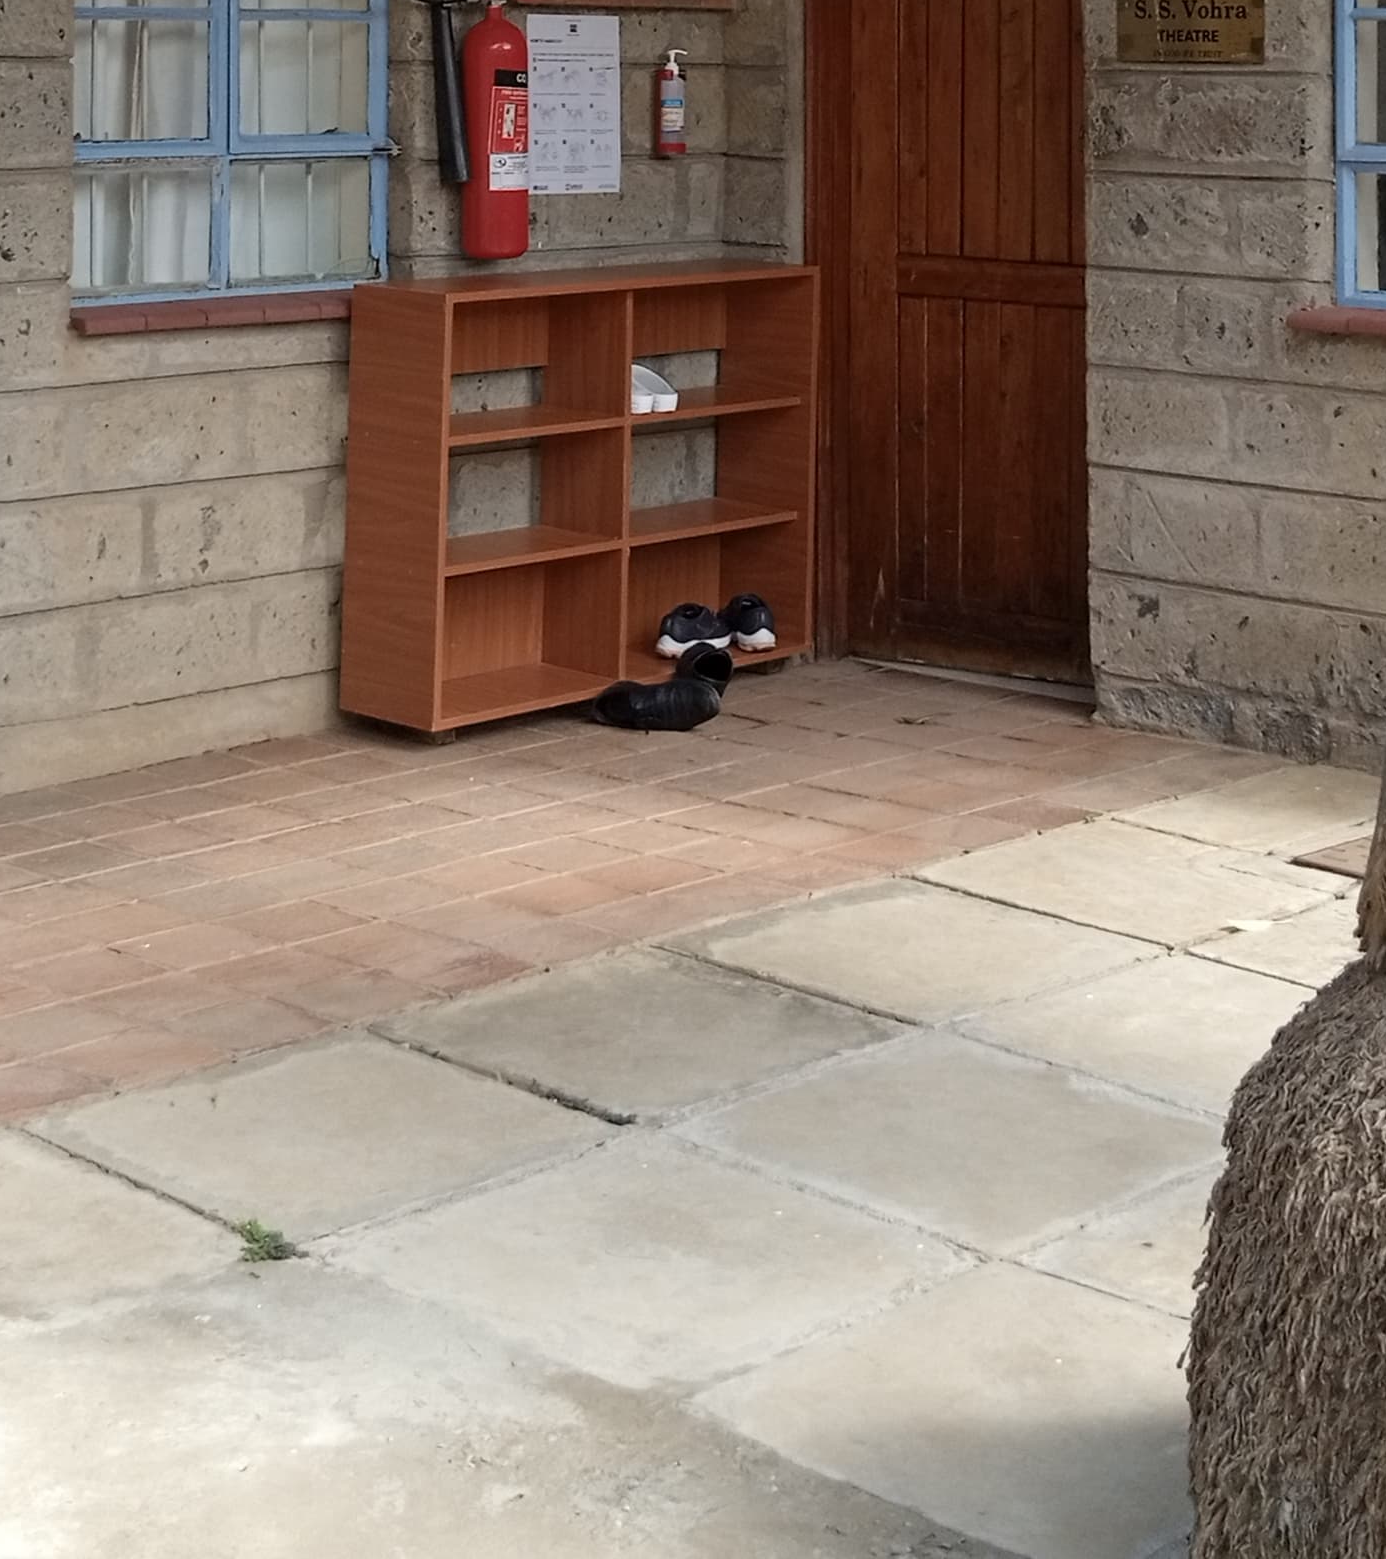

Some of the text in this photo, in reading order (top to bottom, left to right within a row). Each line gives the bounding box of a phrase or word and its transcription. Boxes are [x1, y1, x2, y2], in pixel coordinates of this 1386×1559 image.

[1134, 0, 1248, 19] S. S. Vohra
[1157, 29, 1220, 43] THEATRE
